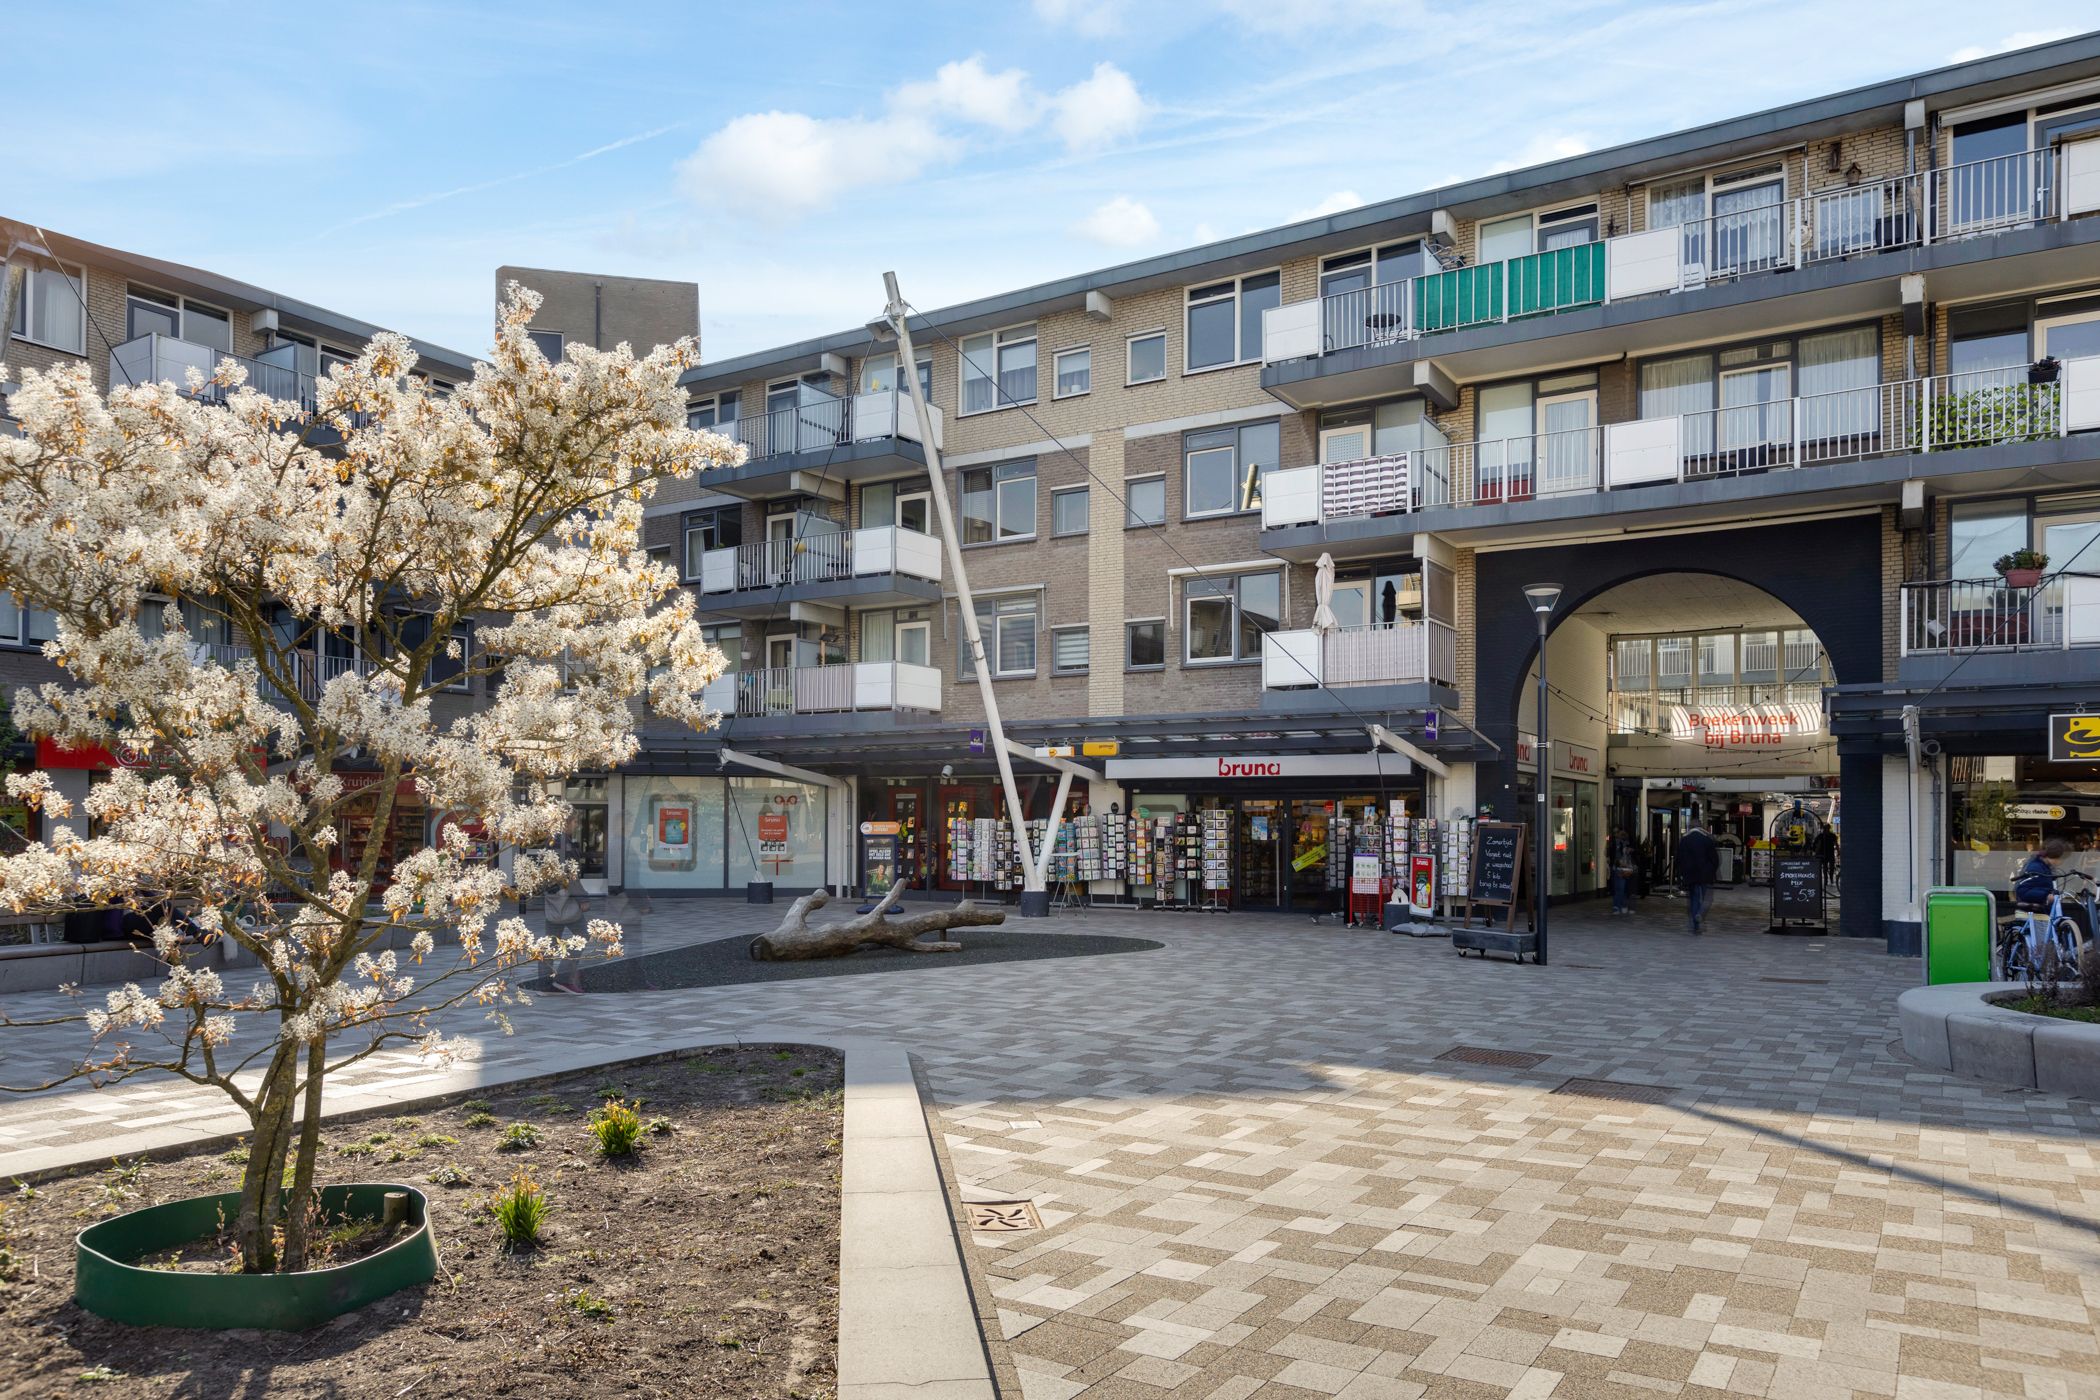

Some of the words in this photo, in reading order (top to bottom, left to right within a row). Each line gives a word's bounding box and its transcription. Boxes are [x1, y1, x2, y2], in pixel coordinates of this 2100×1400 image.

[1690, 712, 1798, 727] Boekenweek
[1705, 730, 1724, 749] bij
[1730, 730, 1782, 744] Bruna
[1517, 743, 1530, 761] una
[1569, 746, 1588, 772] bruna
[1218, 757, 1280, 776] bruna
